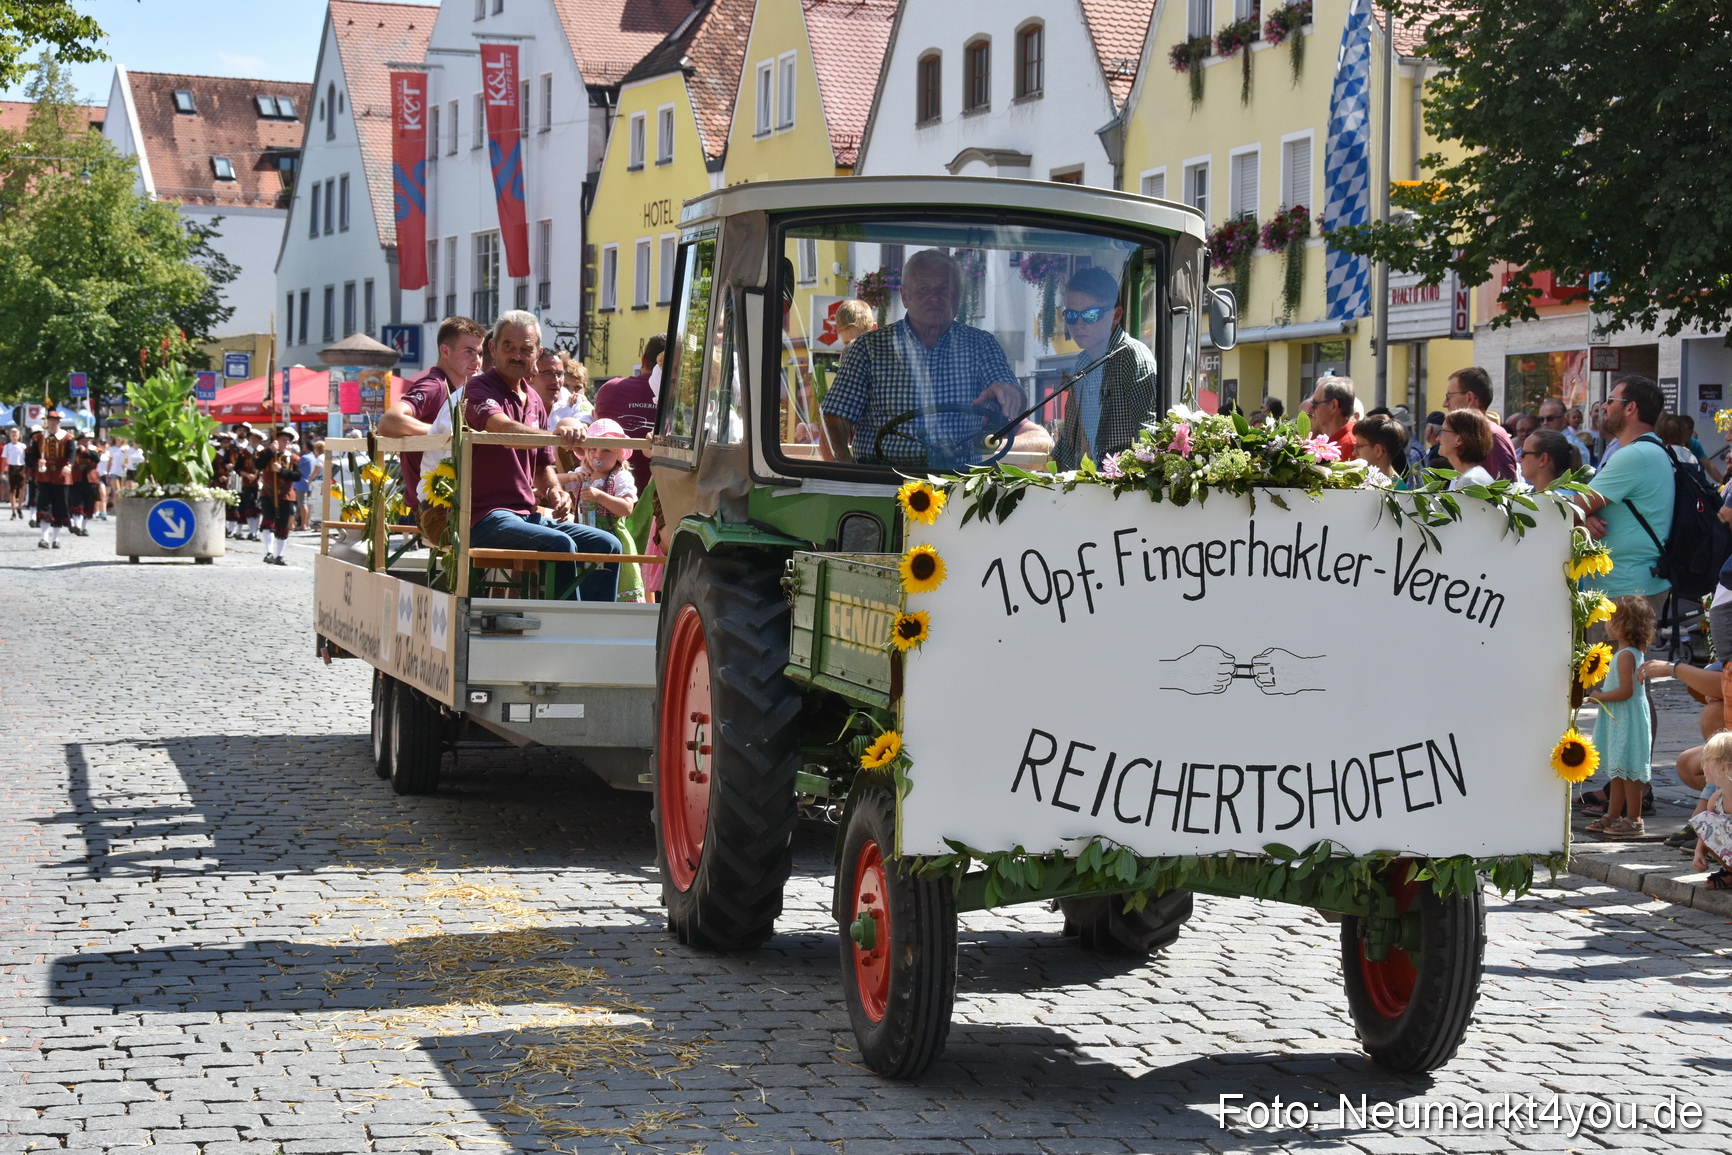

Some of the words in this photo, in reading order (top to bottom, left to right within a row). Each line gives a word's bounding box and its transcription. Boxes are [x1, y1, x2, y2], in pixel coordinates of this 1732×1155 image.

[486, 53, 507, 105] K&L
[505, 53, 514, 106] RUPPERT
[643, 198, 673, 228] HOTEL
[1391, 287, 1419, 305] RIALTO
[1420, 284, 1440, 302] KINO
[71, 388, 86, 396] TAXI
[198, 391, 215, 399] TAXI
[1113, 519, 1506, 629] Fingerhakler-Verein
[829, 590, 900, 660] FENDT
[1011, 728, 1467, 835] REICHERTSHOFEN
